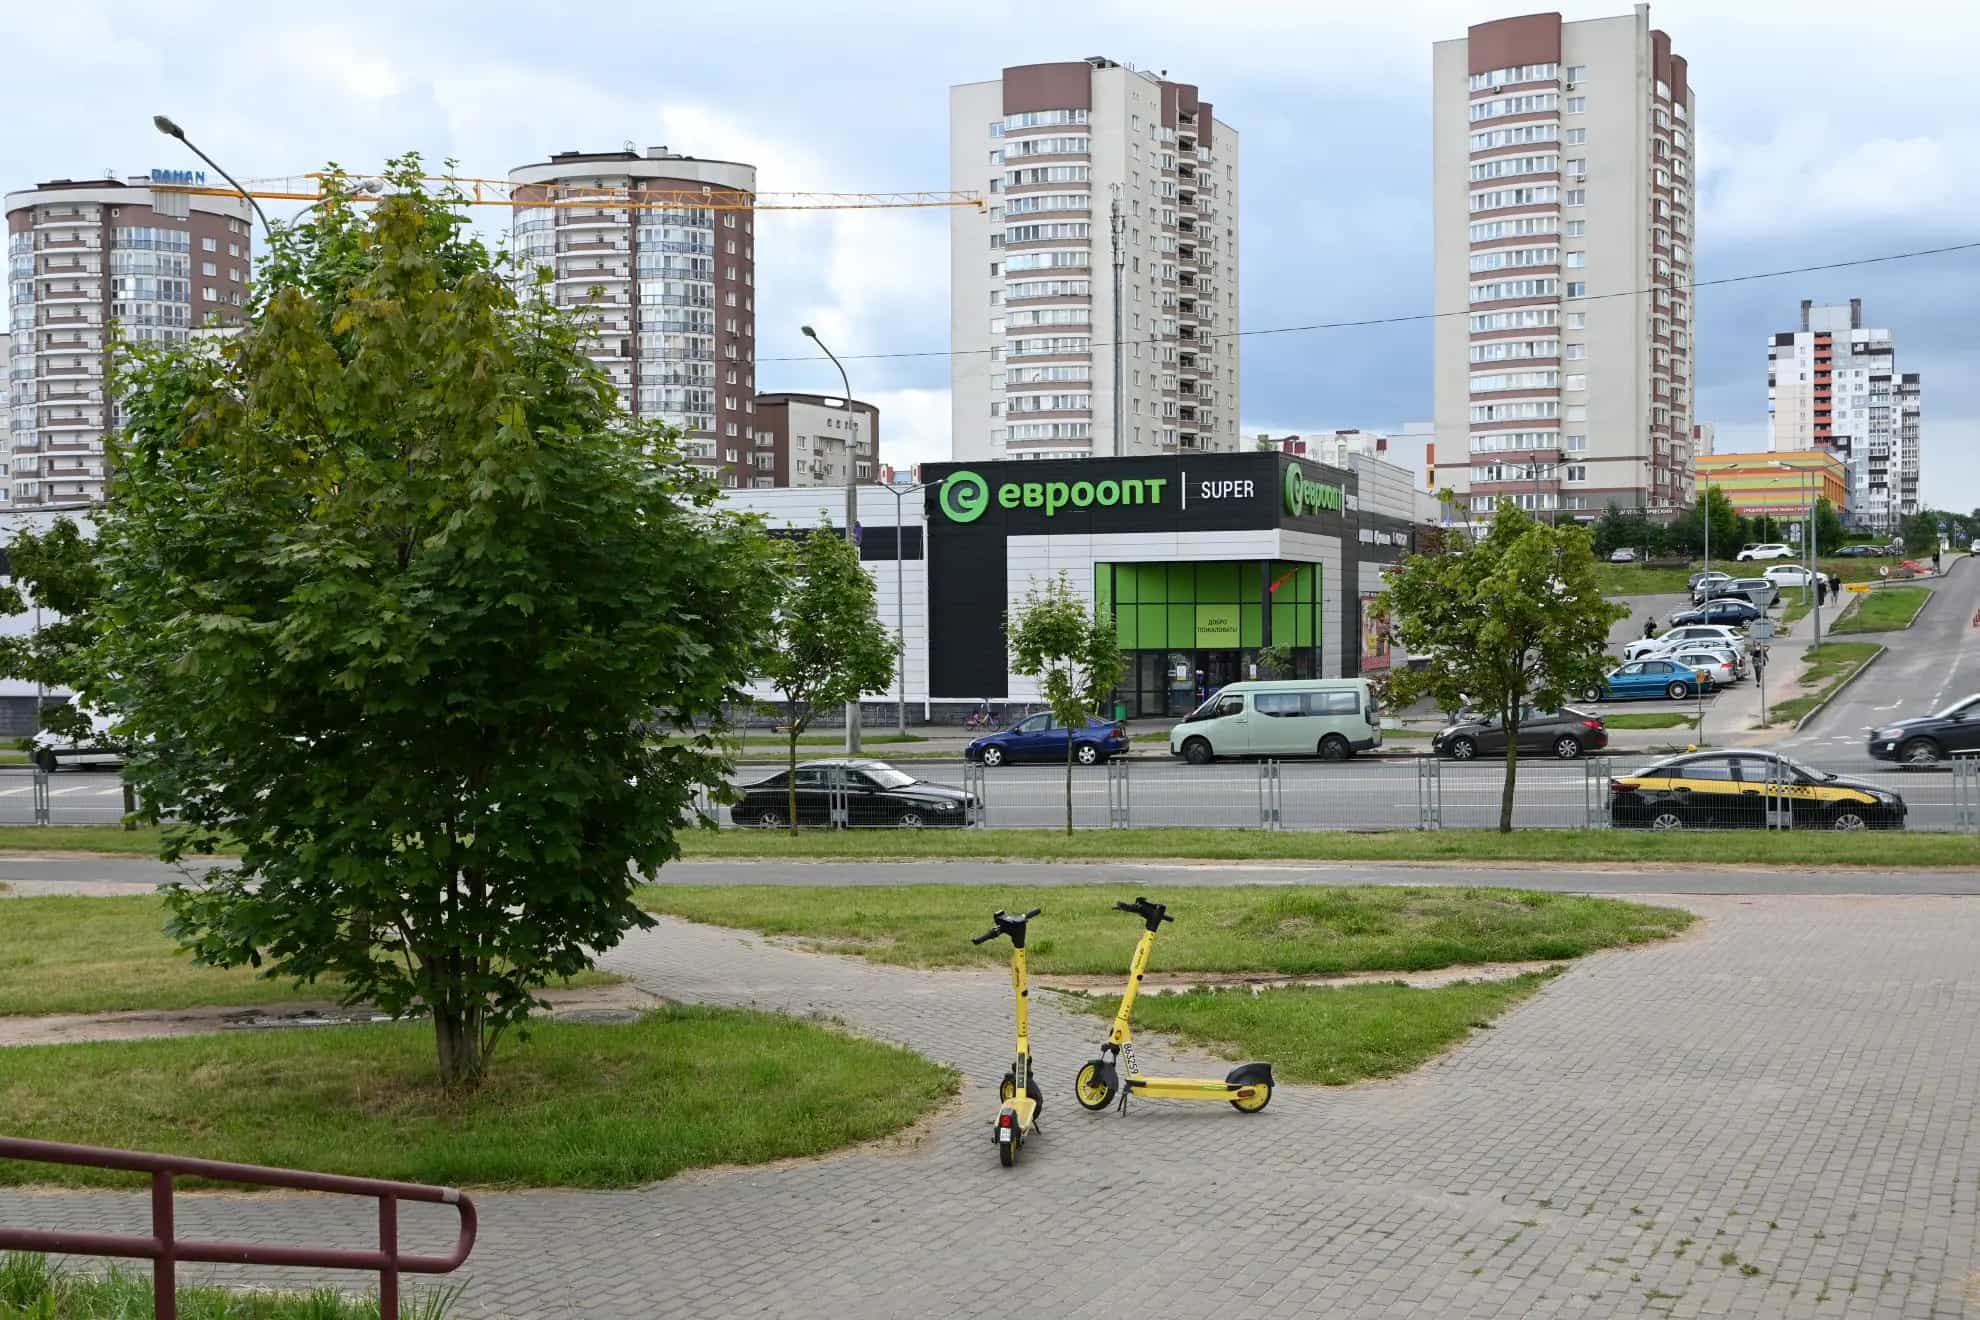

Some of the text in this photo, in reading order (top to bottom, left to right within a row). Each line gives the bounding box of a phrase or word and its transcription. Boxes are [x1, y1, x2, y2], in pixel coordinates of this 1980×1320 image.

[998, 478, 1167, 516] евроопт
[1201, 480, 1255, 499] SUPER
[1303, 480, 1341, 516] евроопт
[1124, 1043, 1139, 1075] 863259
